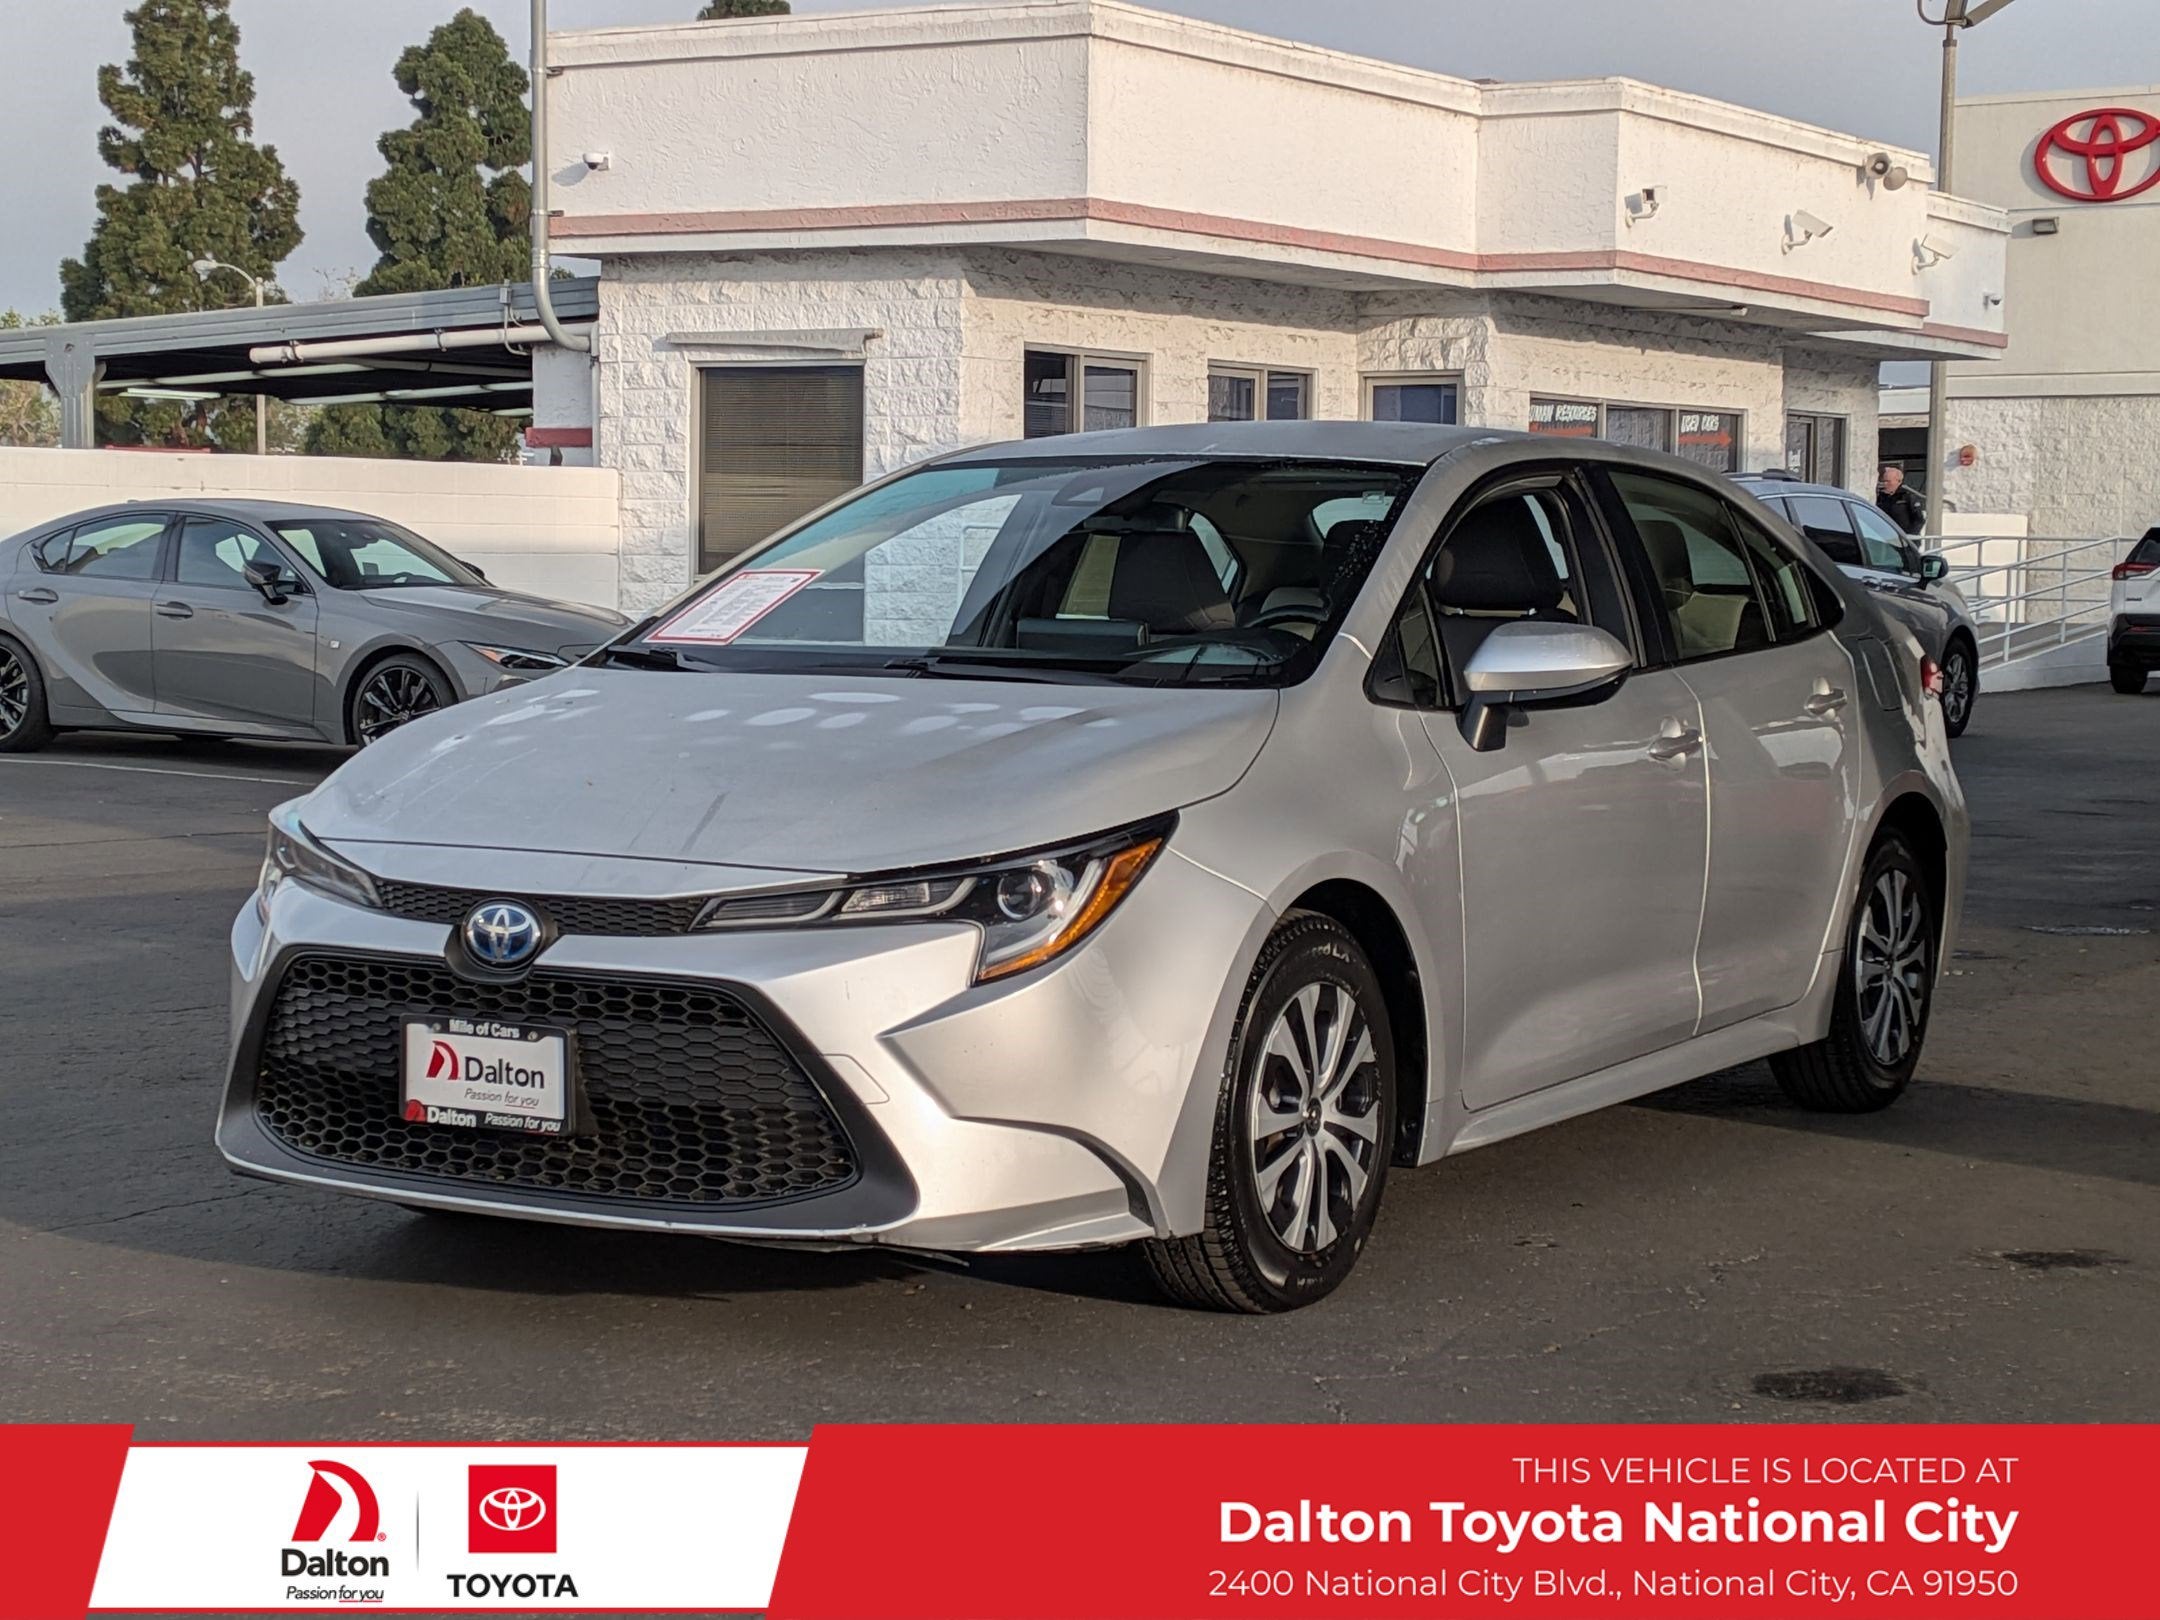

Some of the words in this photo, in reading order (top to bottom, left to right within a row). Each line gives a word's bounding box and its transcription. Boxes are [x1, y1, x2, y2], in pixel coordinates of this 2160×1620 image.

[449, 1019, 474, 1033] Mile
[476, 1022, 489, 1036] of
[491, 1023, 520, 1038] Cars
[465, 1056, 544, 1089] Dalton
[464, 1088, 502, 1102] Passion
[504, 1090, 518, 1104] for
[520, 1096, 539, 1107] you
[427, 1107, 477, 1127] Dalton
[484, 1113, 522, 1128] Passion
[524, 1116, 540, 1130] for
[541, 1120, 561, 1132] you
